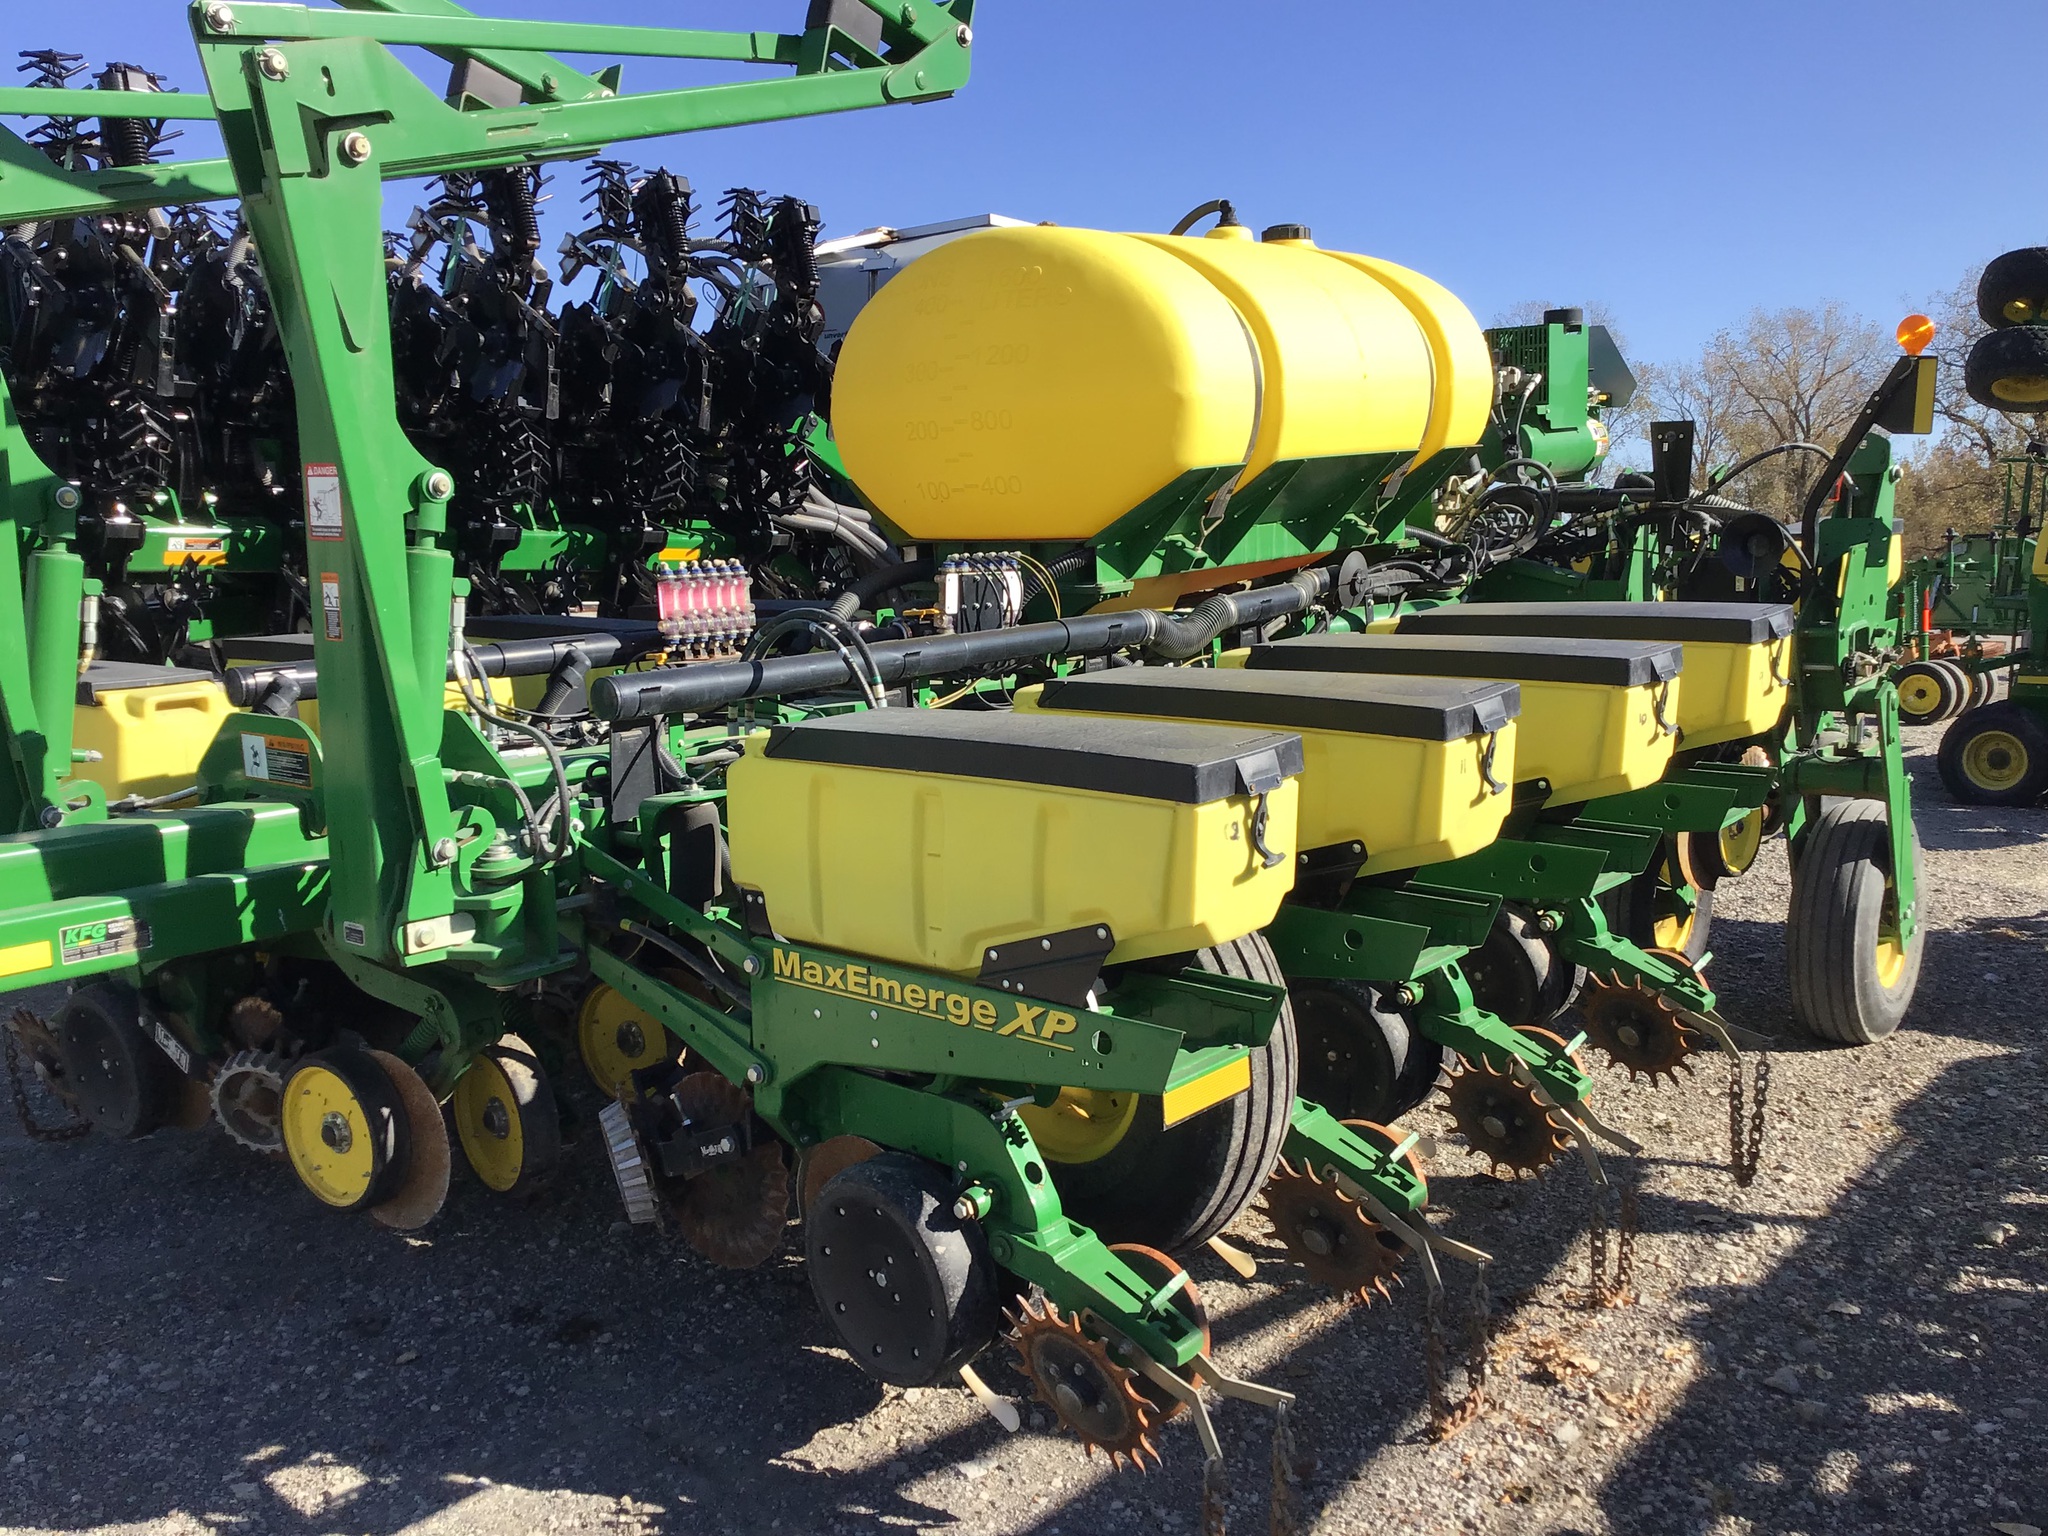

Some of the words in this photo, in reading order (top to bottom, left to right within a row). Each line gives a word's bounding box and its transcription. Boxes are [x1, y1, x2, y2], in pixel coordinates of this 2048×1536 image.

[971, 343, 1030, 367] 1200
[904, 360, 939, 384] 300
[905, 420, 940, 442] 200
[970, 409, 1013, 432] 800
[916, 481, 951, 501] 100
[980, 475, 1023, 496] 400
[64, 923, 107, 944] KFG
[773, 947, 997, 1026] MaxEmerge
[995, 1001, 1078, 1040] XP
